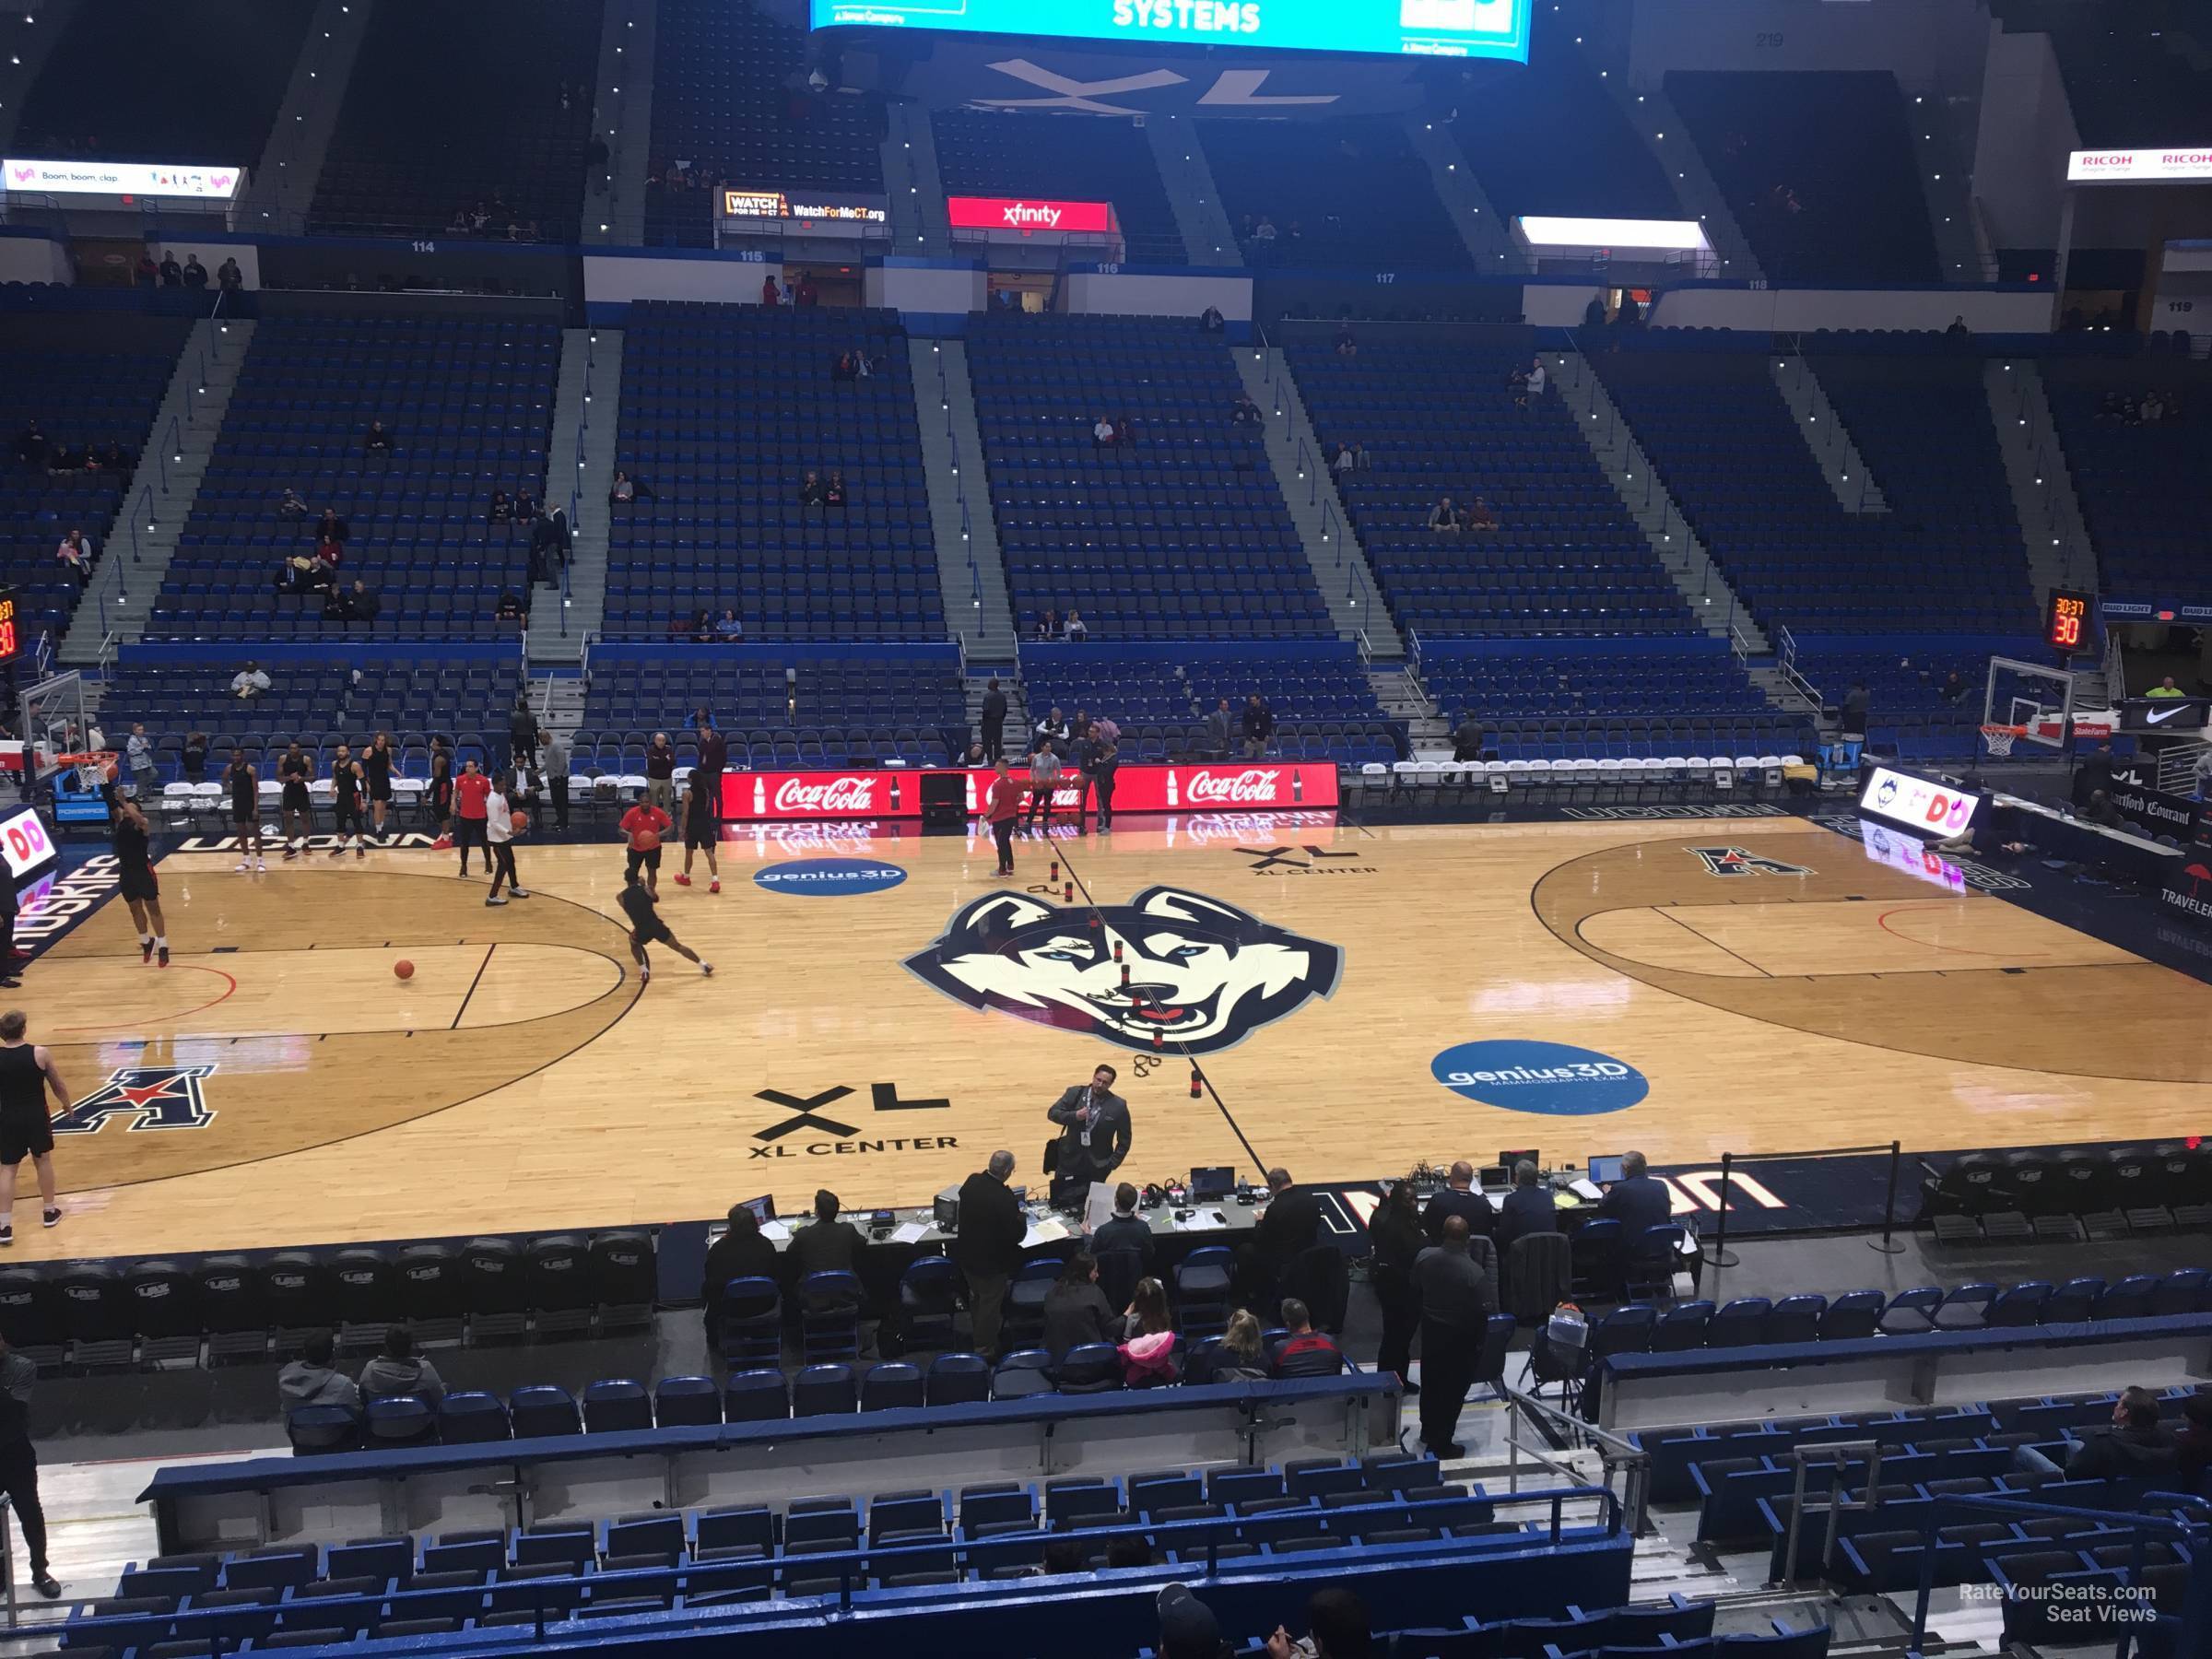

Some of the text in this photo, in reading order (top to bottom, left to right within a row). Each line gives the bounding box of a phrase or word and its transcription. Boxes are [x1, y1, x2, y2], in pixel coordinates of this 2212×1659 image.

[1112, 0, 1261, 33] SYSTEMS
[1756, 33, 1784, 48] 219
[2082, 155, 2133, 166] RICOH
[2161, 153, 2212, 164] RICOH
[731, 195, 778, 210] WATCH
[794, 205, 885, 222] WatchForMeCT.org
[1003, 202, 1062, 227] xfinity
[412, 241, 434, 253] 114
[740, 251, 763, 263] 115
[1097, 262, 1119, 275] 116
[1375, 273, 1395, 284] 117
[1749, 279, 1768, 290] 118
[2169, 302, 2193, 313] 119
[2056, 598, 2084, 616] 30:37
[2123, 605, 2150, 613] LIGHT
[2055, 617, 2079, 643] 30
[2111, 790, 2191, 826] artford Courant
[752, 869, 903, 882] genius3D
[1287, 866, 1380, 876] CENTER
[1441, 1062, 1630, 1087] genius3D
[1490, 1077, 1590, 1087] MAMMOGRAPHY
[752, 1082, 952, 1142] XL
[747, 1135, 959, 1159] XL CENTER
